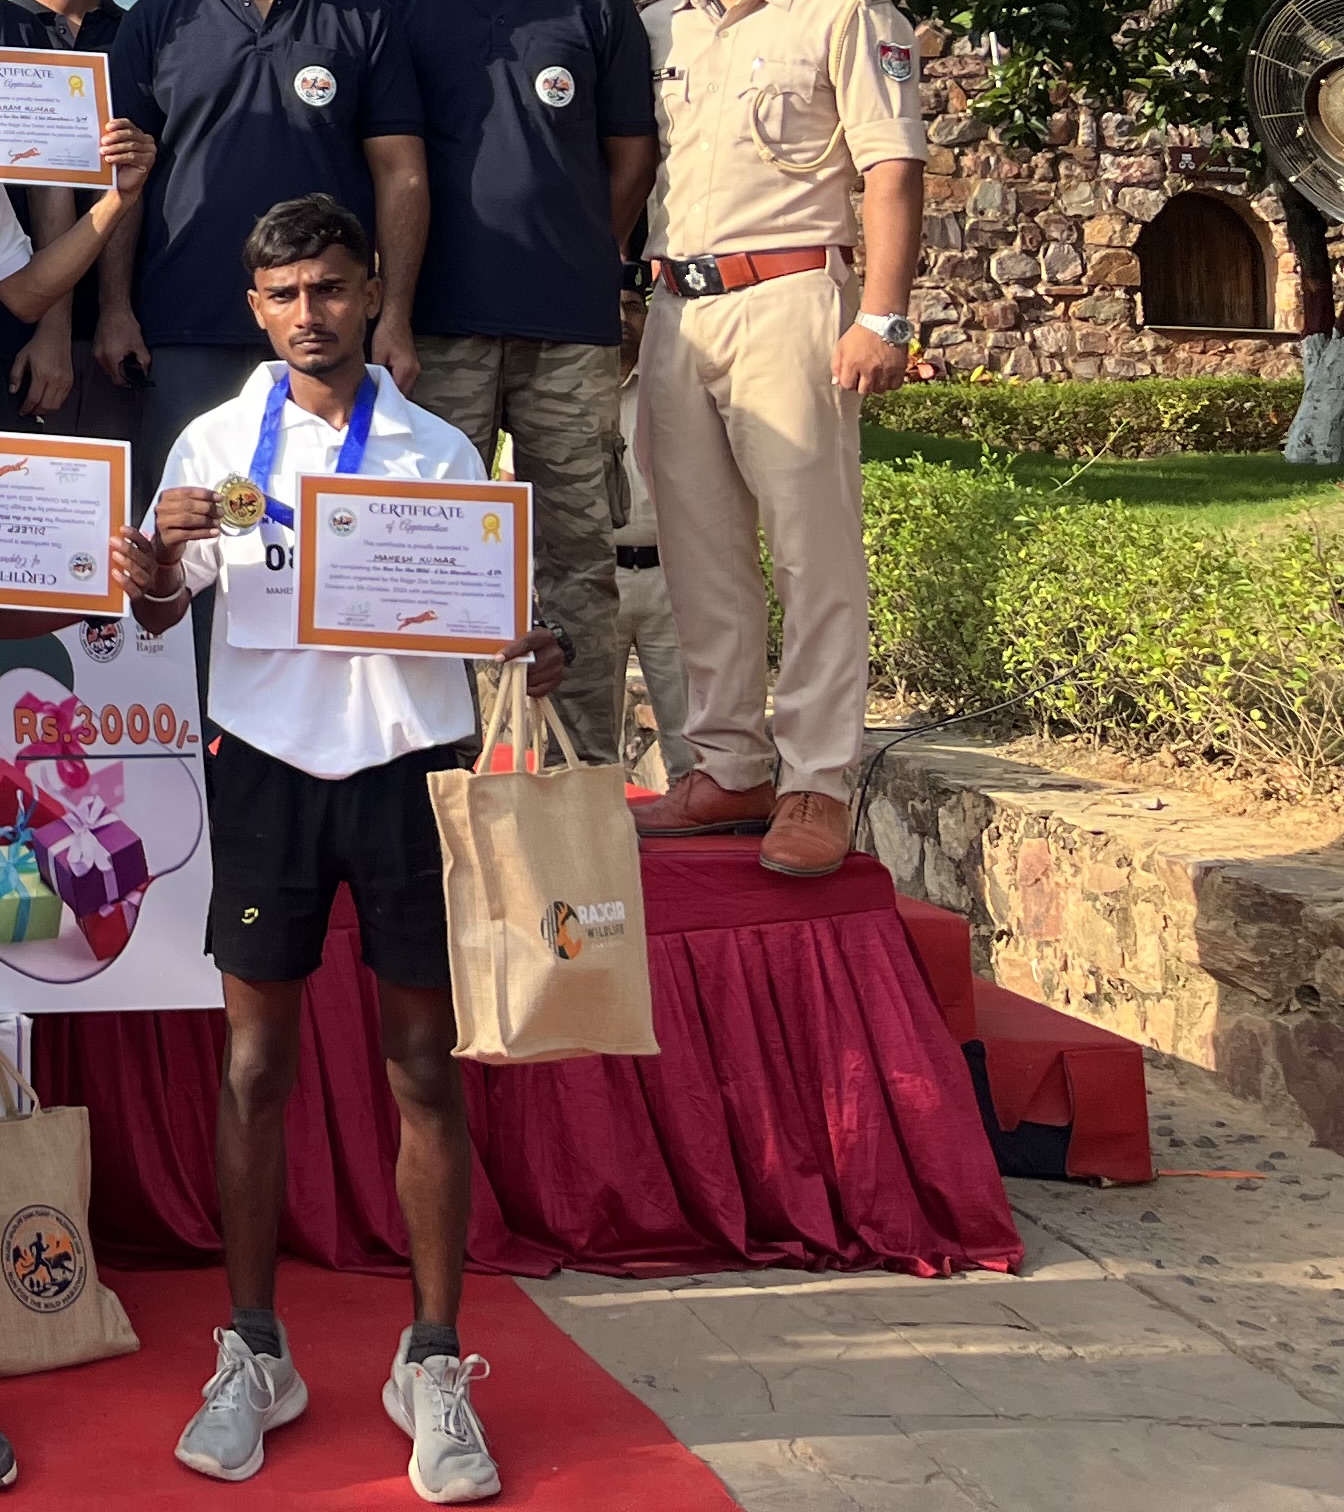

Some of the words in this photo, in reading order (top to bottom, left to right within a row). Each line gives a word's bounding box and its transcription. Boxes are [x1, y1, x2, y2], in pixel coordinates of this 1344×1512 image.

[368, 502, 463, 520] CERTIFICATE
[135, 640, 165, 655] Rajgir
[13, 703, 199, 750] Rs.3000/-
